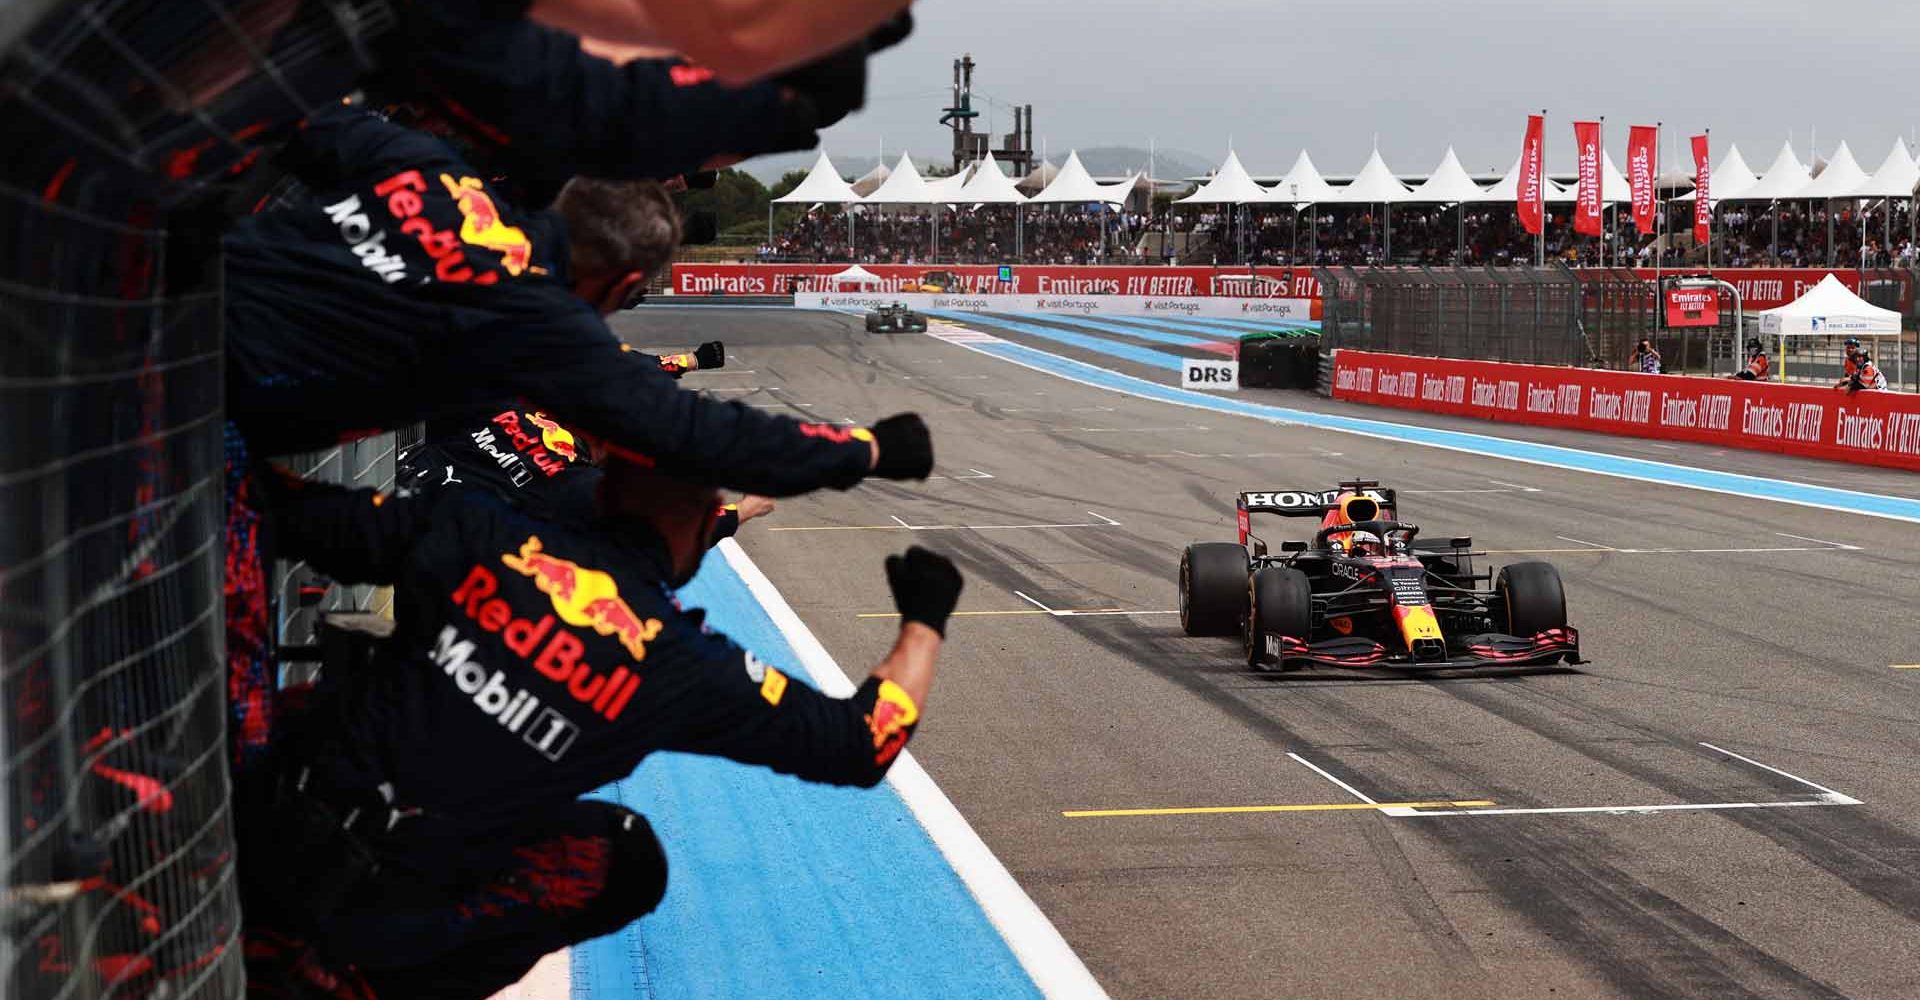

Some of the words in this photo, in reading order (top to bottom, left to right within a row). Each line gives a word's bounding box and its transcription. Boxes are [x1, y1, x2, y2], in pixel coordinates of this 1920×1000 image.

[681, 273, 766, 293] Emirates
[1038, 276, 1120, 295] Emirates
[1127, 277, 1147, 296] FLY
[1151, 277, 1193, 296] BETTER
[1295, 277, 1315, 297] FLY
[1737, 280, 1751, 300] FLY
[1751, 280, 1783, 301] BETTER
[1671, 293, 1712, 303] Emirates
[1189, 366, 1232, 383] DRS
[1527, 382, 1555, 414] Emirates
[1589, 386, 1622, 421] Emirates
[1622, 389, 1635, 421] FLY
[1631, 391, 1651, 423] BETTER
[1661, 391, 1697, 426] Emirates
[1698, 394, 1711, 428] FLY
[1708, 395, 1732, 430] BETTER
[1742, 398, 1784, 437] Emirates
[1785, 402, 1800, 441] FLY
[1797, 403, 1823, 442] BETTER
[1836, 407, 1884, 450] Emirates
[1885, 412, 1902, 453] FLY
[1898, 413, 1920, 456] BETTE
[1331, 562, 1359, 581] ORACLE
[452, 564, 556, 659] Red
[533, 628, 641, 722] Bull
[428, 625, 540, 732] Mobil
